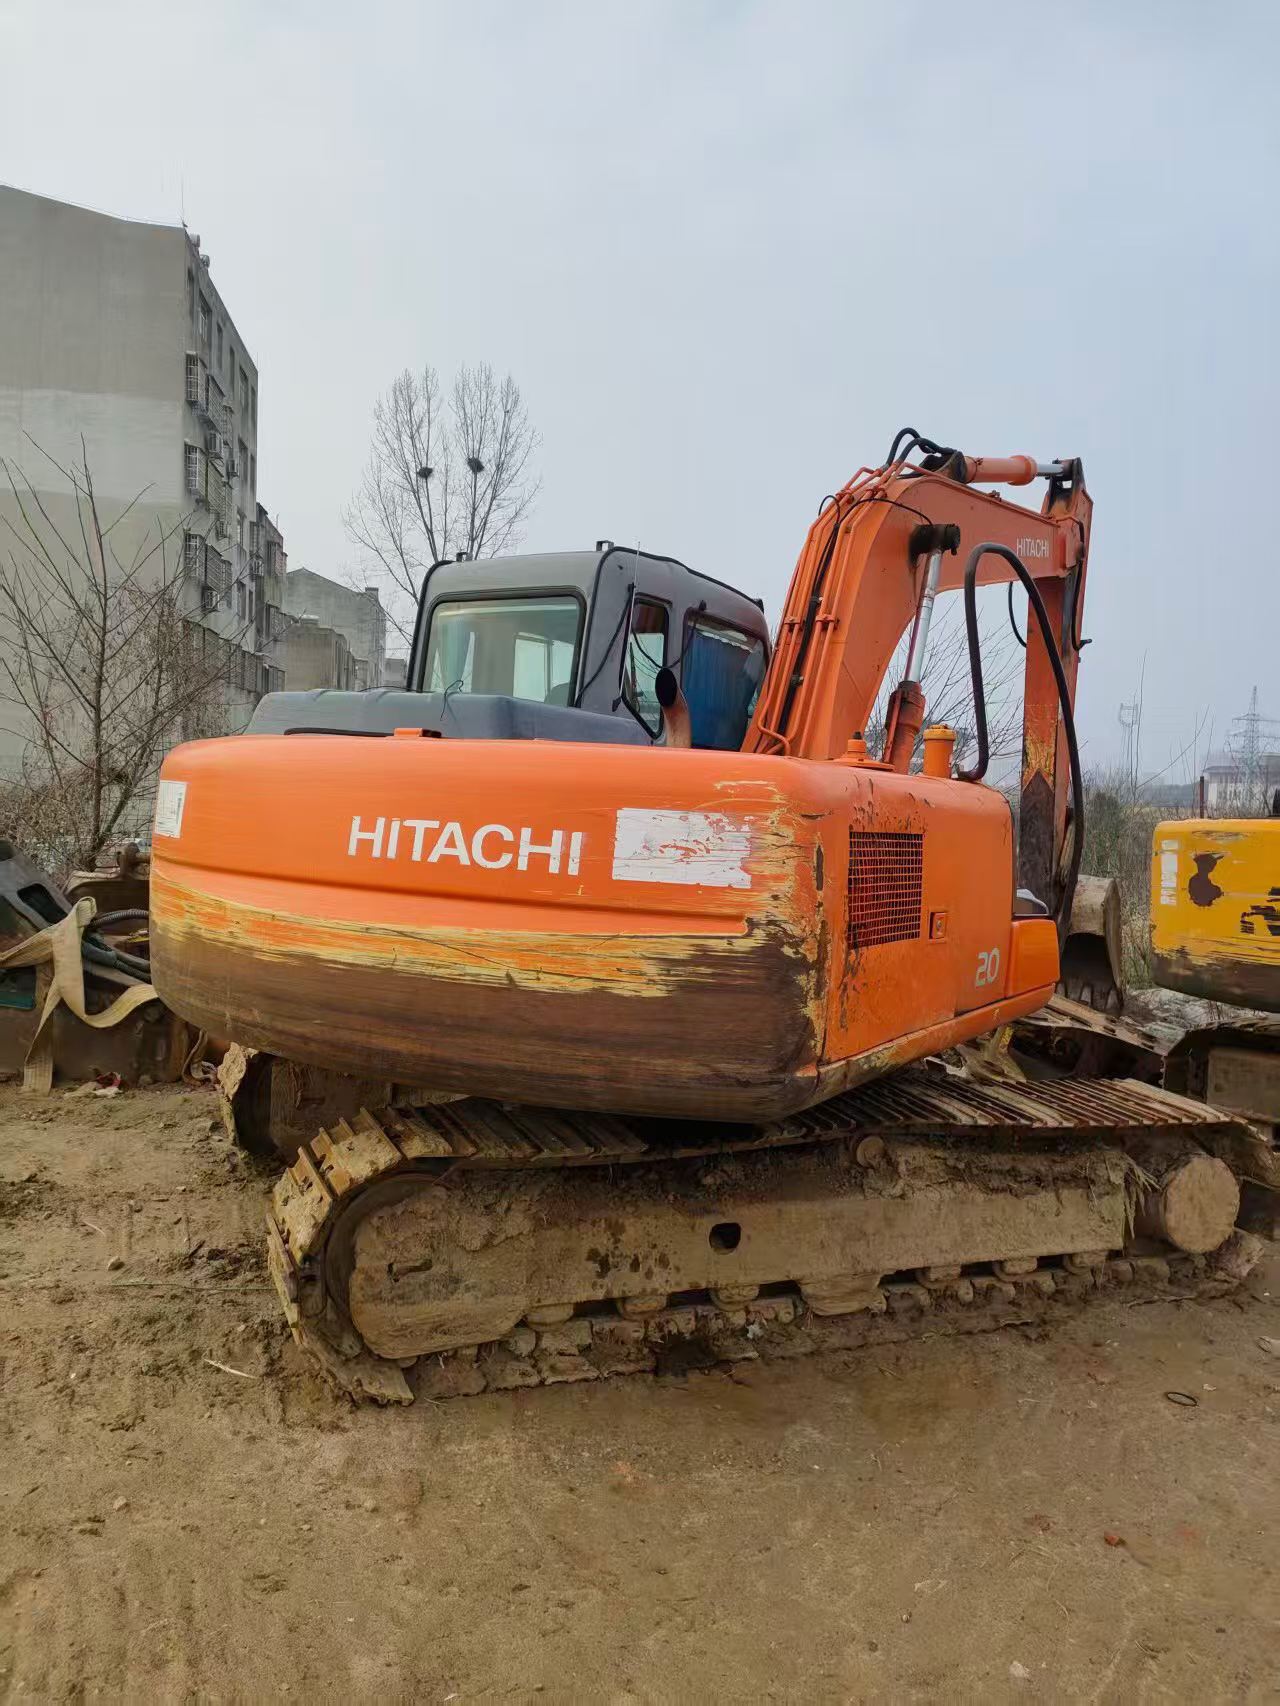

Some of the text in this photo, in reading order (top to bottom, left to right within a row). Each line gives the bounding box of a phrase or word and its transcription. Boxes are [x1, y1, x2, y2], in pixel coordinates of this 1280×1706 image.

[1016, 538, 1050, 558] HITACHI
[347, 815, 583, 876] HITACHI
[975, 947, 1000, 987] 20
